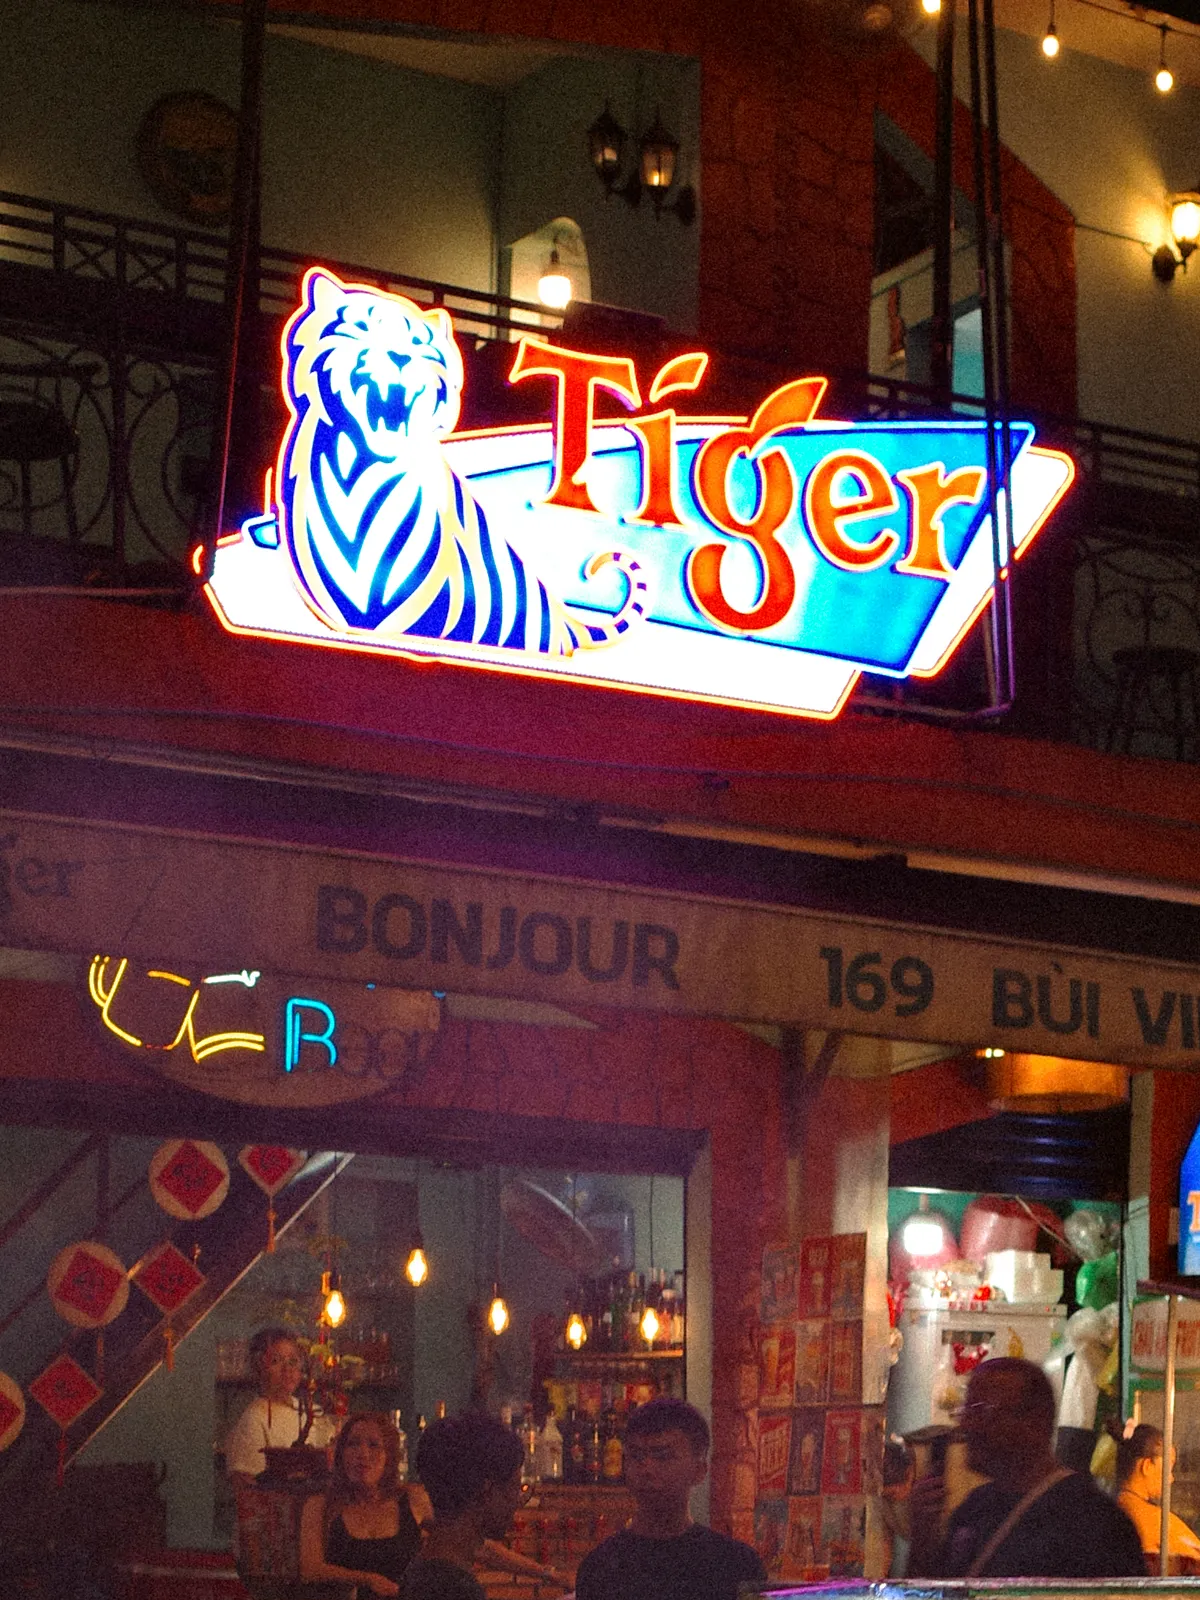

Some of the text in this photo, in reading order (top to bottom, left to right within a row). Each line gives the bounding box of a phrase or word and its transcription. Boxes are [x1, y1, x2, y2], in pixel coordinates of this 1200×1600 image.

[509, 339, 984, 632] Tiger
[316, 886, 680, 990] BONJOUR
[820, 947, 935, 1017] 169
[992, 962, 1100, 1038] BÙI
